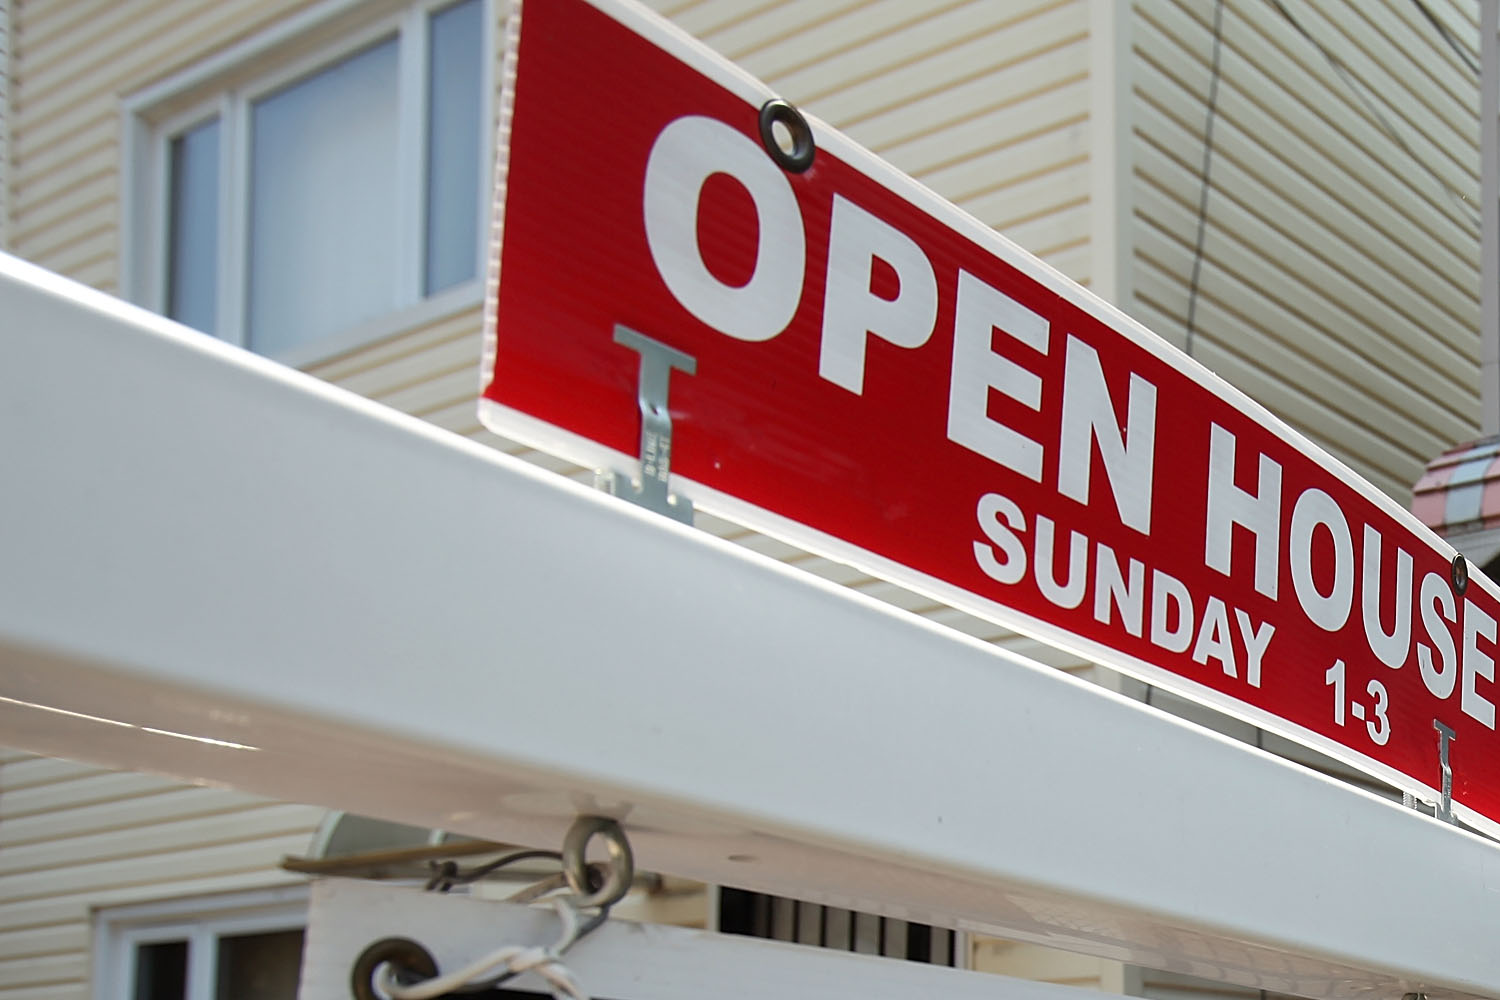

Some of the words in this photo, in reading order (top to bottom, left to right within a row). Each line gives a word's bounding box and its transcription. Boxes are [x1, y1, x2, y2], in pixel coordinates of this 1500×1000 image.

[644, 116, 1157, 536] OPEN
[1205, 422, 1497, 730] HOUSE
[974, 494, 1275, 688] SUNDAY
[1326, 659, 1391, 746] 1-3
